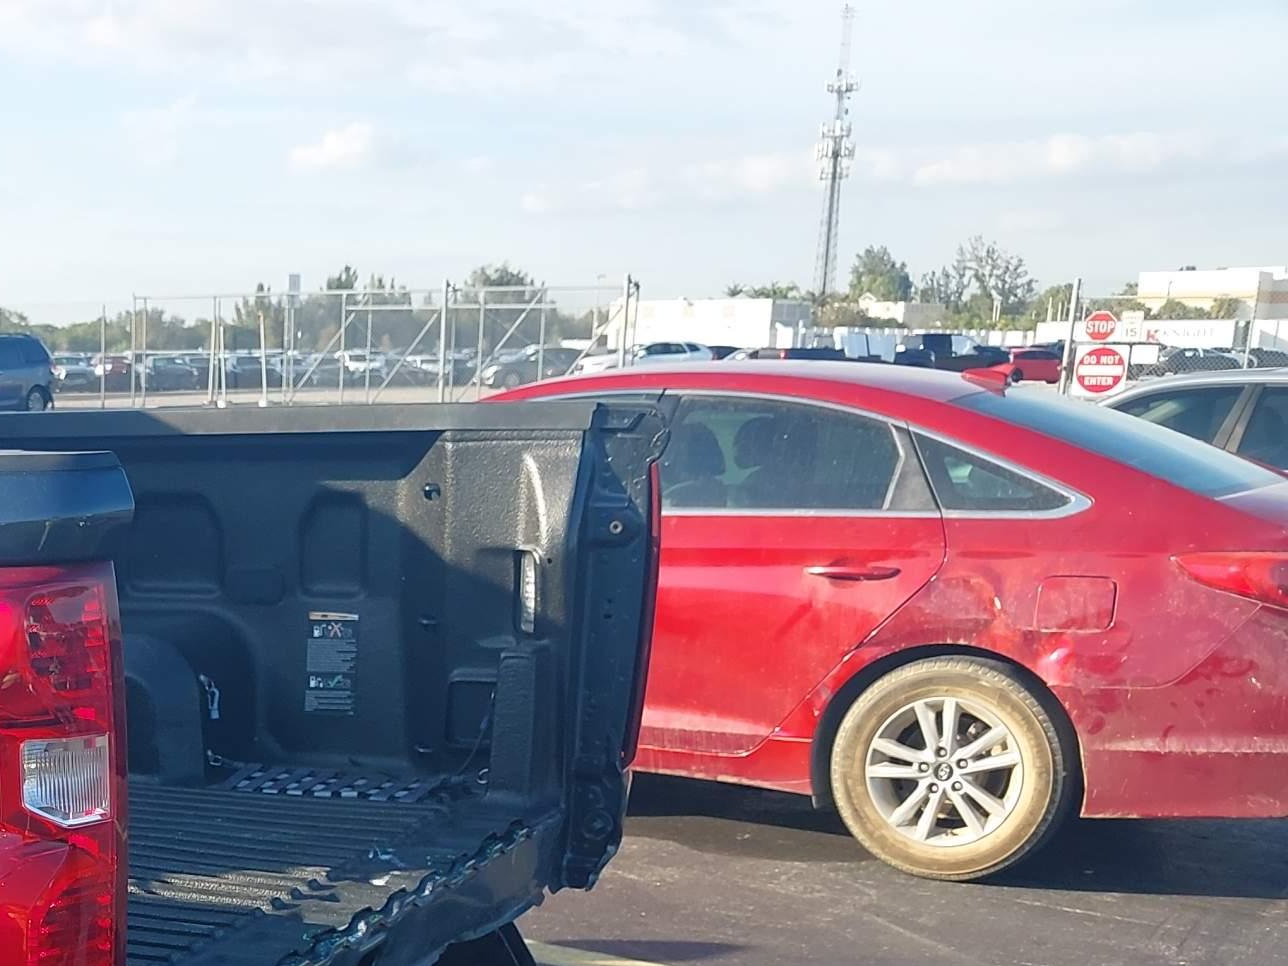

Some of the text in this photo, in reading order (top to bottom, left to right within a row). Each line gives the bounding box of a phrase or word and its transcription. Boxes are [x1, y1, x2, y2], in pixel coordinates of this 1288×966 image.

[1087, 321, 1115, 333] STOP
[1126, 327, 1137, 337] 15
[1083, 354, 1120, 364] DO NOT
[1083, 376, 1113, 386] ENTER
